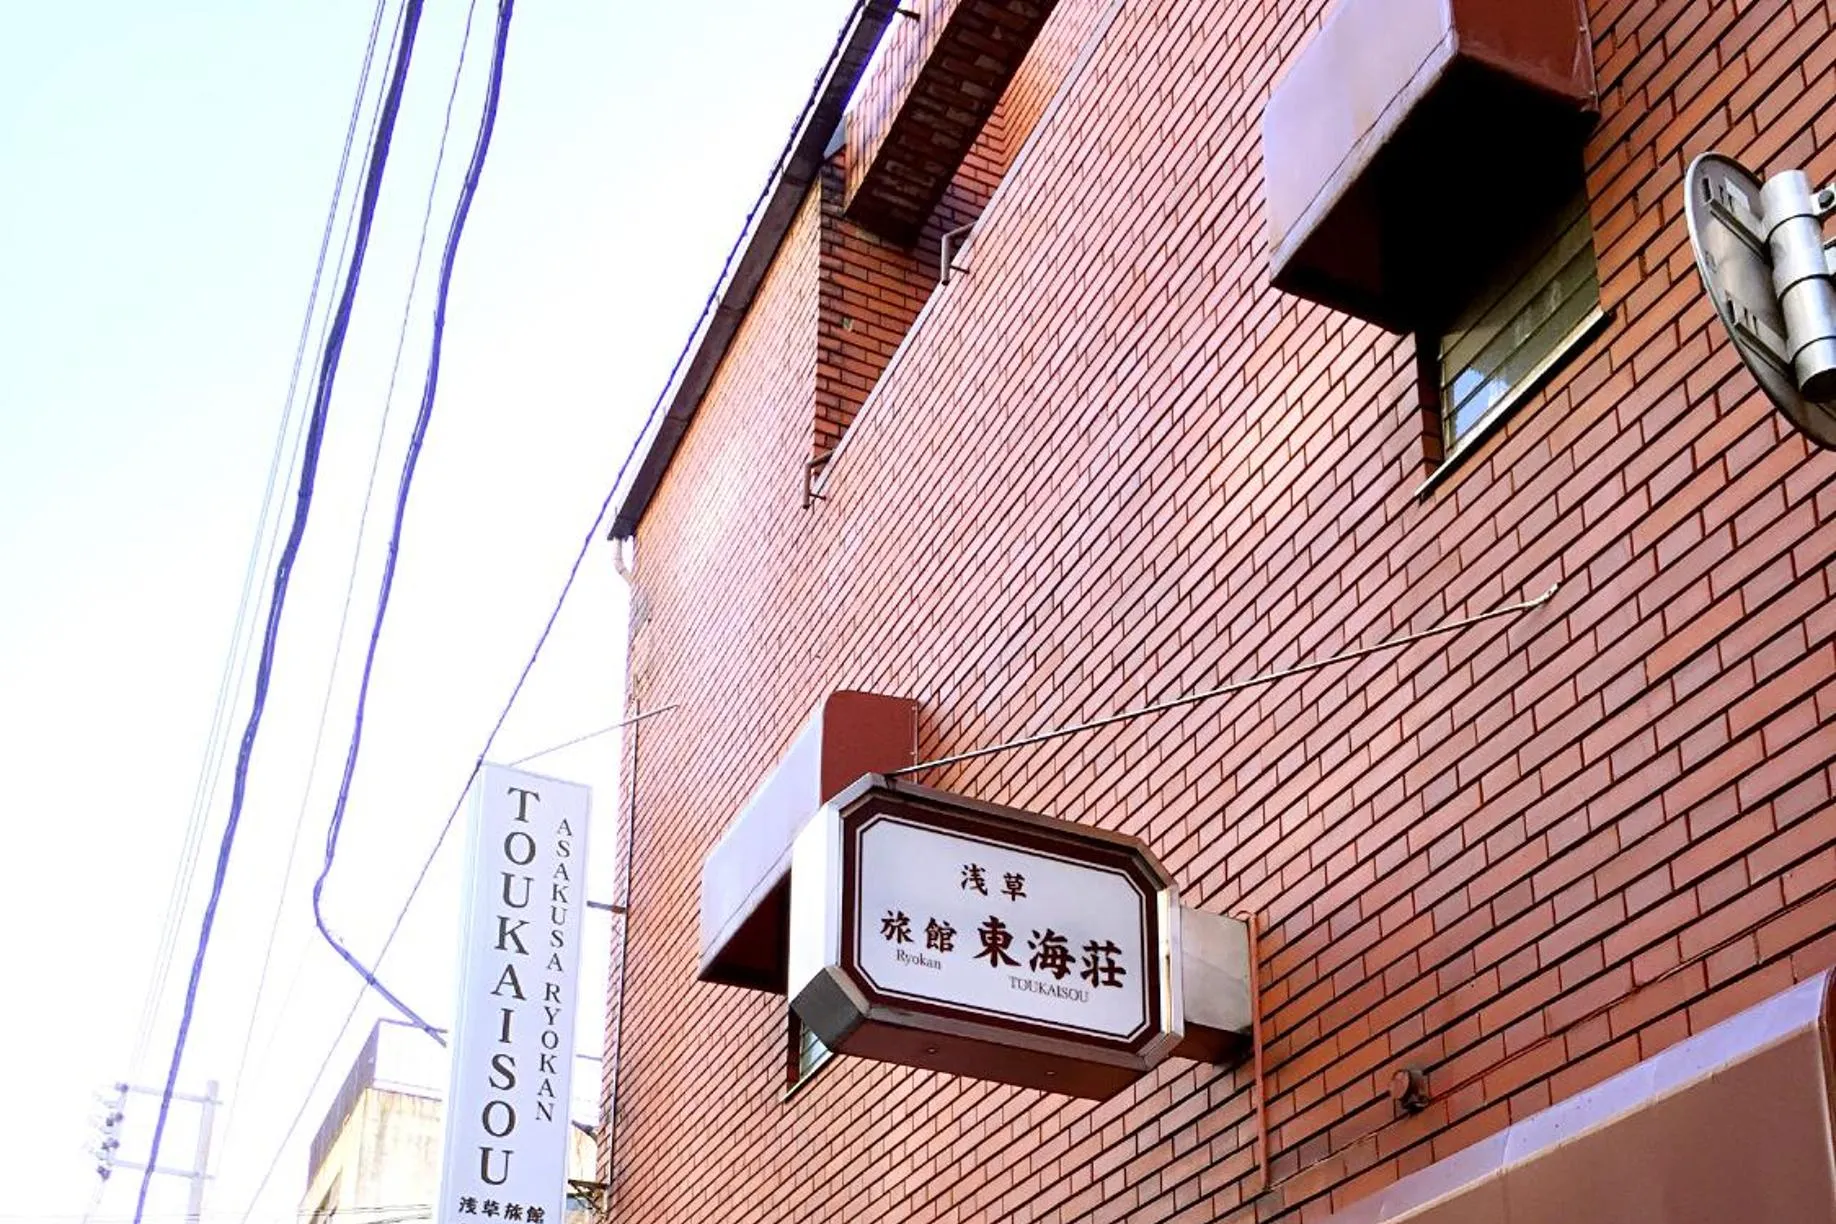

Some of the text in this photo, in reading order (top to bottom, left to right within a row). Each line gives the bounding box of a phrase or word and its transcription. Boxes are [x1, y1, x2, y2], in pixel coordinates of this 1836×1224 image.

[960, 862, 1028, 902] 浅草
[879, 909, 1127, 989] 旅館 東海荘
[895, 948, 943, 971] Ryokan
[478, 786, 541, 1186] TOUKAISOU
[535, 817, 573, 1123] ASAKUSA RYOKAN
[1008, 975, 1090, 1004] TOUKAISOU
[458, 1195, 546, 1224] 浅草旅館
